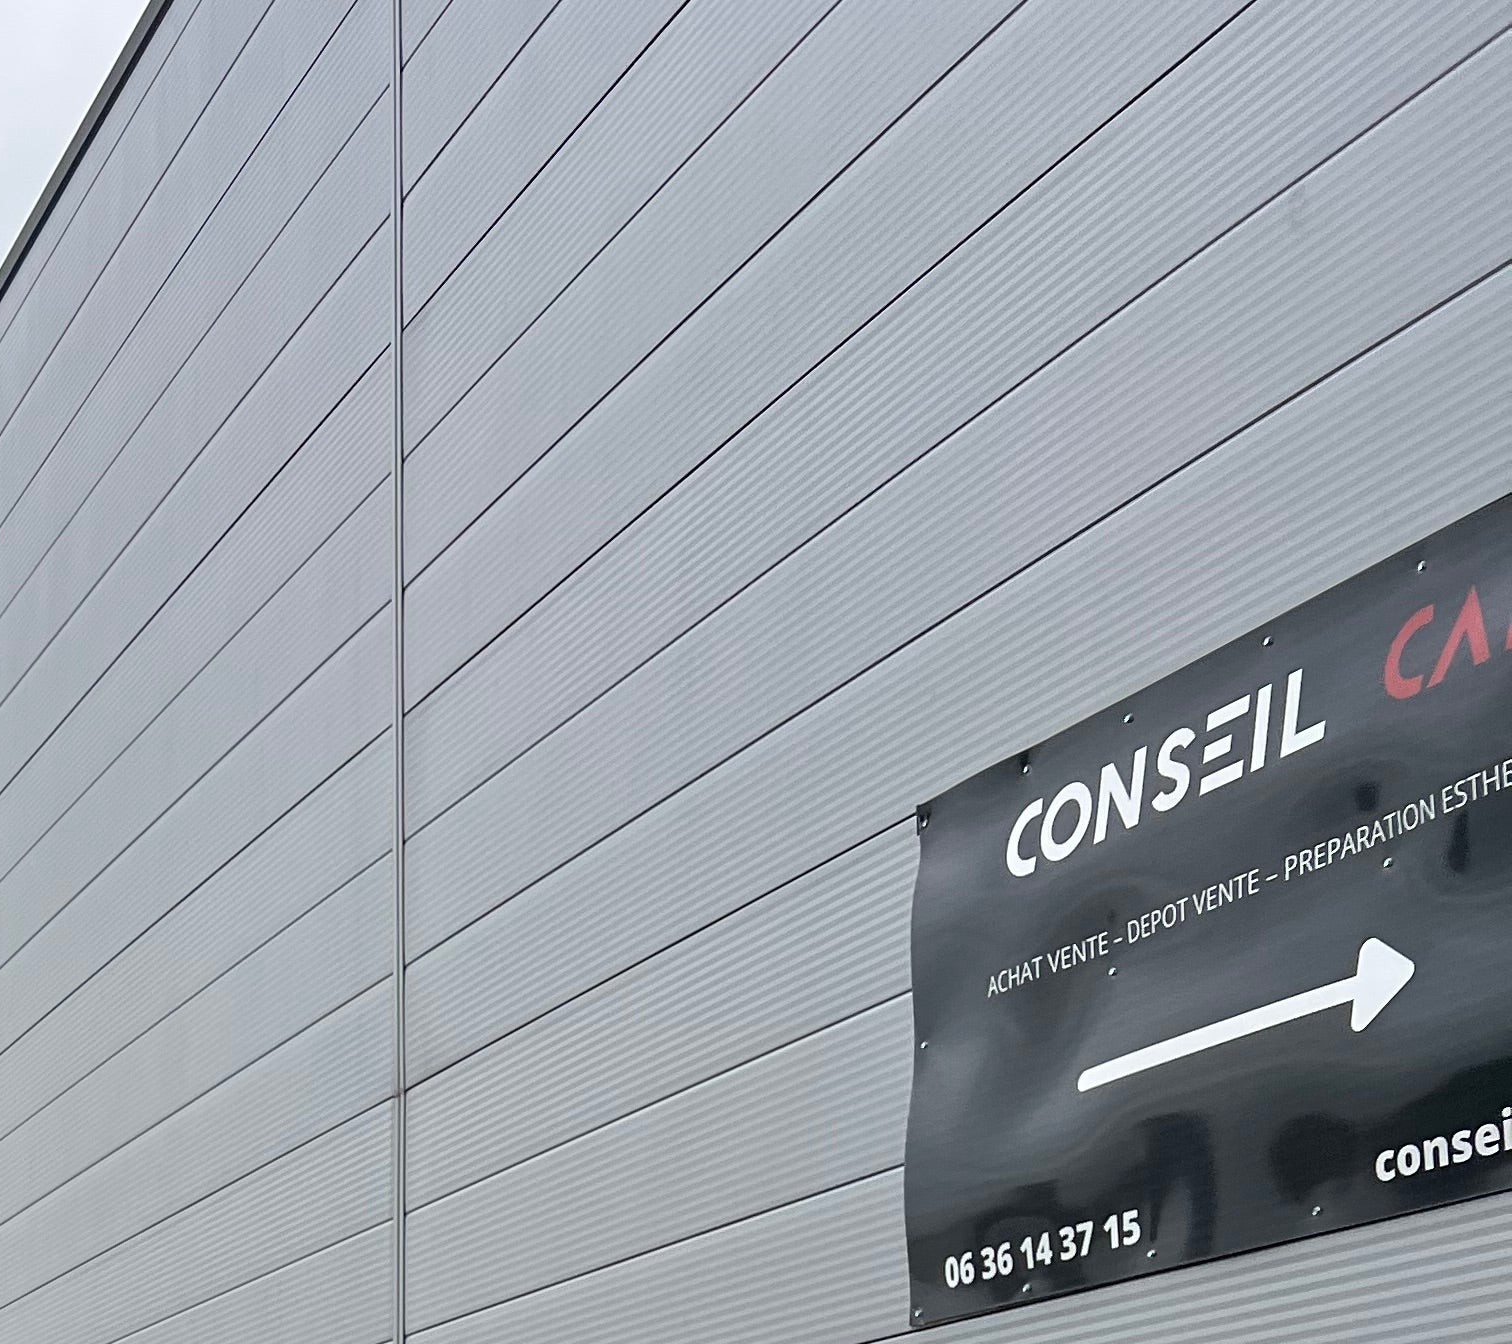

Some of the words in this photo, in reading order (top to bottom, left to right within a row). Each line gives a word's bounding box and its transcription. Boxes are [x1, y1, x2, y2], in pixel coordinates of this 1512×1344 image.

[1005, 668, 1327, 877] CONSEIL
[1384, 584, 1512, 700] CA
[987, 955, 1044, 999] ACHAT
[1046, 931, 1110, 973] VENTE
[1127, 896, 1189, 944] DEPOT
[1192, 868, 1260, 915] VENTE
[1284, 794, 1436, 882] PREPARATION
[1441, 758, 1512, 814] ESTHE
[1375, 1106, 1512, 1182] consei
[944, 1255, 975, 1289] 06
[981, 1241, 1014, 1280] 36
[1020, 1232, 1053, 1270] 14
[1059, 1220, 1094, 1262] 37
[1103, 1209, 1142, 1250] 15
